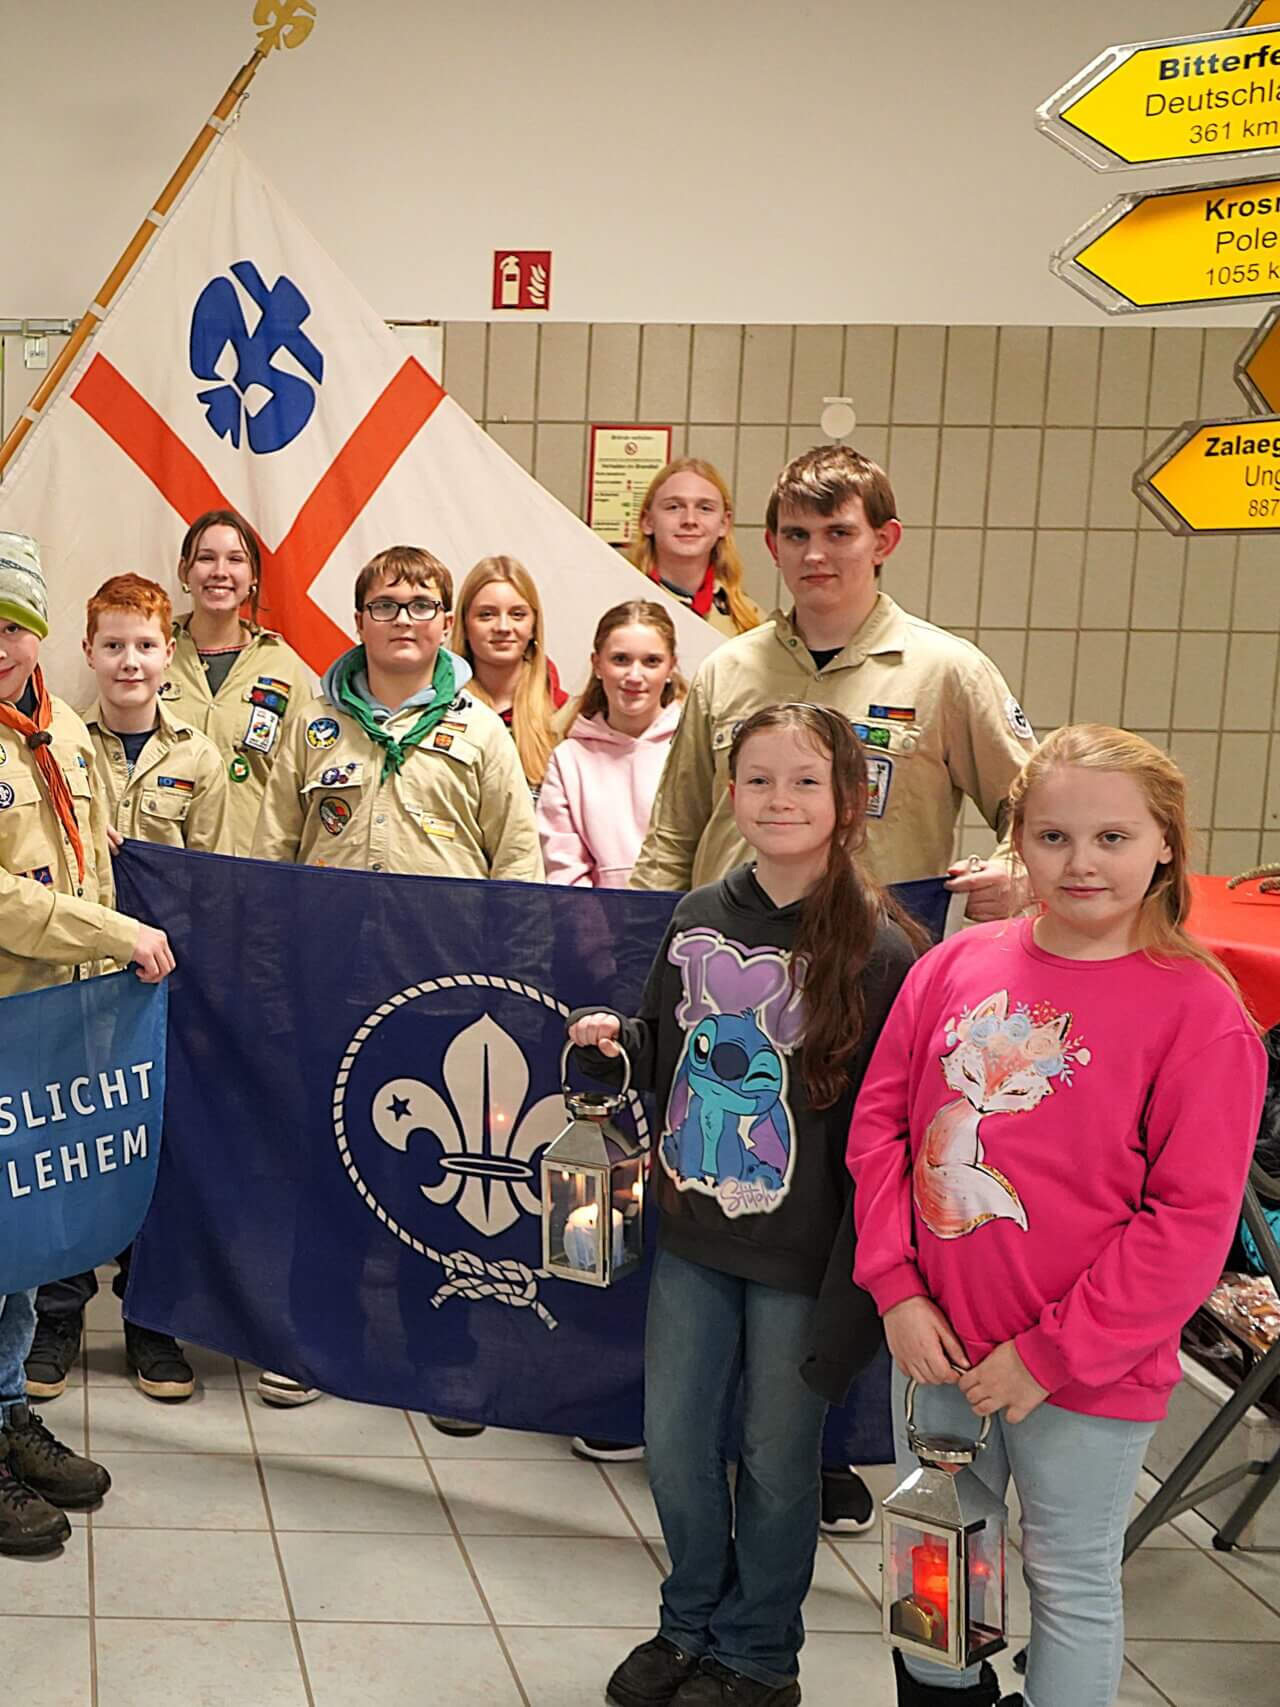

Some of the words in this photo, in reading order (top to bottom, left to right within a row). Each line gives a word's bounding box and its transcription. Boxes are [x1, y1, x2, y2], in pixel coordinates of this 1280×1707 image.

[1158, 45, 1280, 81] Bitterfe
[1189, 121, 1231, 144] 361
[1242, 119, 1278, 138] km
[1216, 226, 1278, 254] Pole
[1206, 263, 1260, 286] 1055
[1268, 260, 1280, 280] k
[1204, 435, 1280, 458] Zalaeg
[1245, 464, 1280, 491] Ung
[1248, 498, 1280, 517] 887
